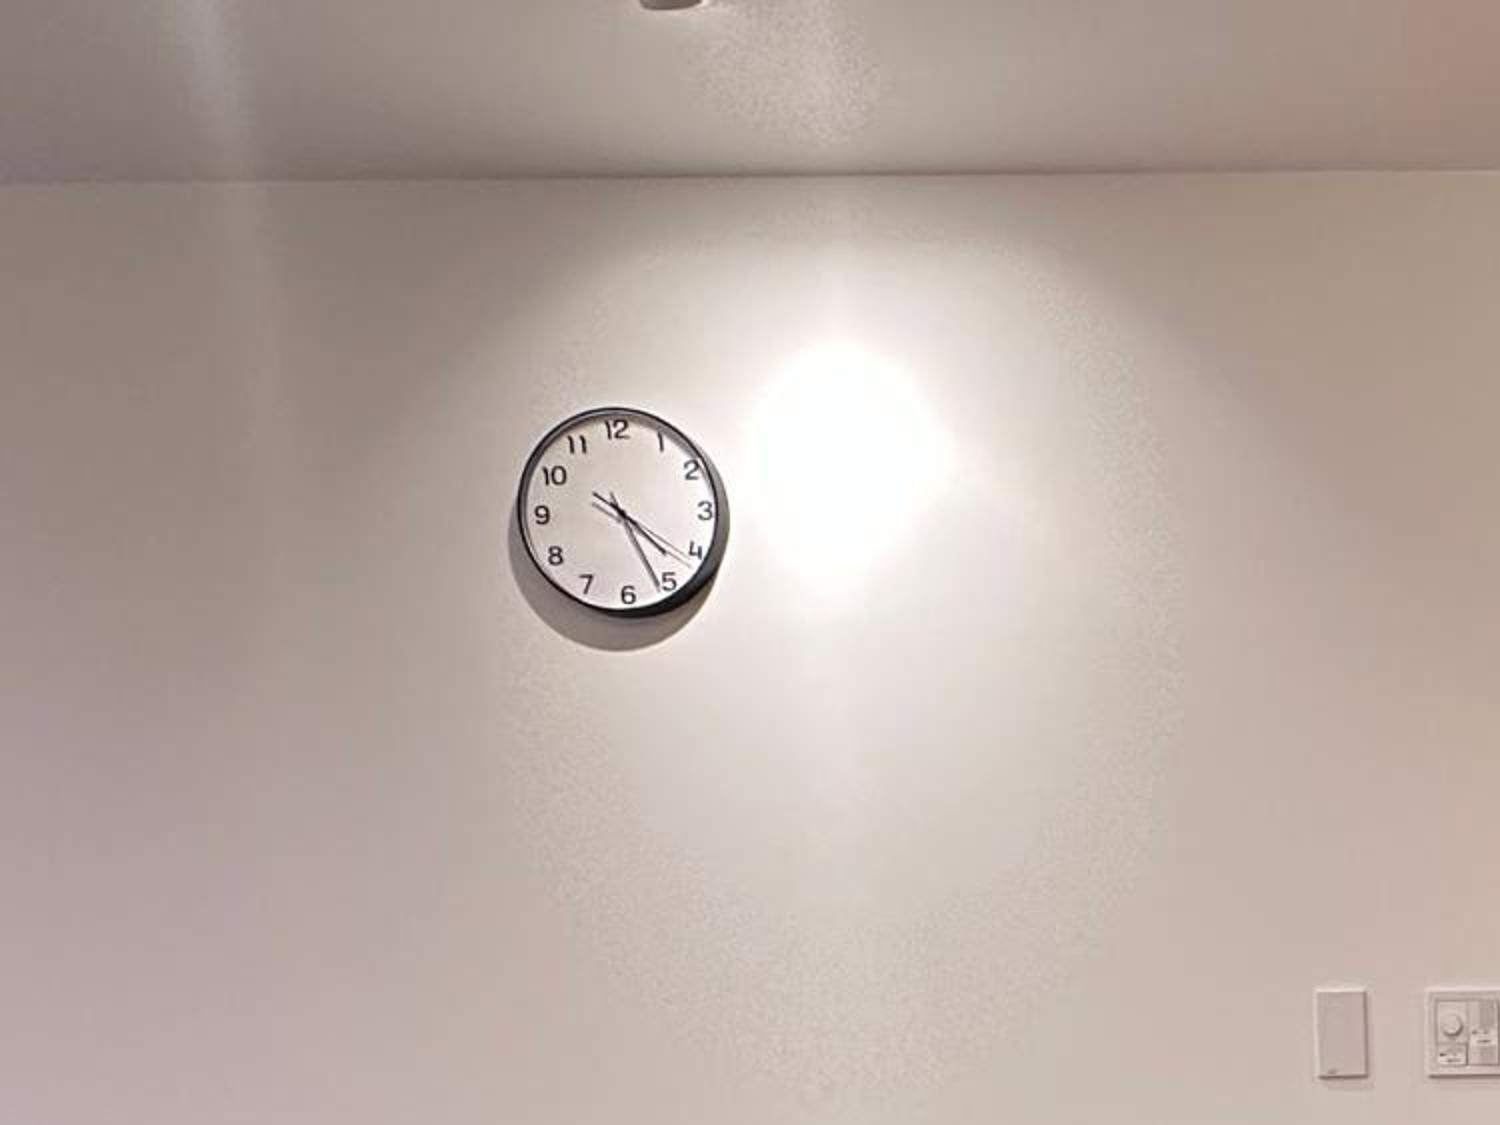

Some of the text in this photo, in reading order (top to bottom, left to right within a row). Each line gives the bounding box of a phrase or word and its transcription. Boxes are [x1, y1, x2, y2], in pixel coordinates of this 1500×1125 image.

[605, 420, 629, 439] 12
[568, 435, 588, 454] 11
[657, 432, 664, 452] 1
[542, 466, 566, 485] 10
[683, 460, 700, 480] 2
[534, 505, 550, 525] 9
[697, 501, 713, 521] 3
[547, 546, 564, 566] 8
[689, 541, 703, 560] 4
[578, 574, 594, 595] 7
[661, 572, 678, 591] 5
[620, 586, 637, 605] 6
